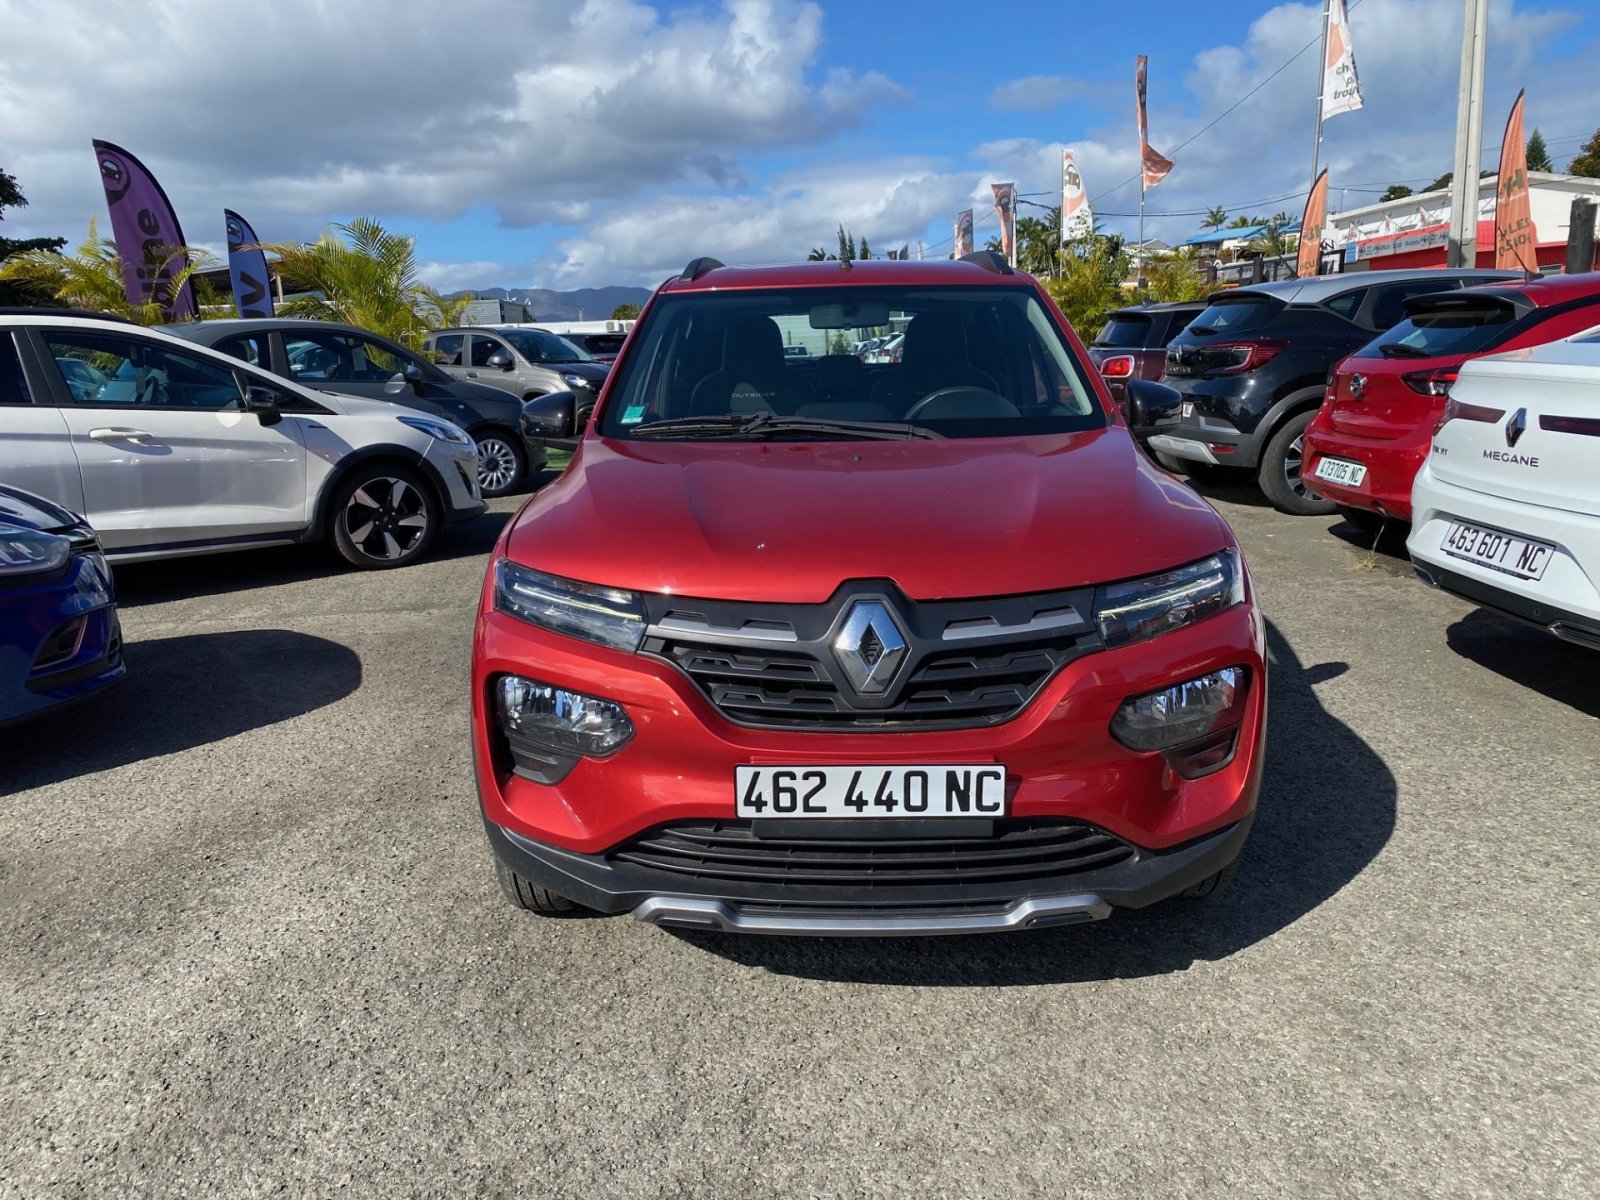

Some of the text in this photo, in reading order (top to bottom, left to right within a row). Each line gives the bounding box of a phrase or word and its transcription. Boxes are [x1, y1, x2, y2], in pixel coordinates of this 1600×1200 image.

[1483, 449, 1540, 467] MEGANE
[1348, 466, 1363, 483] NC
[1448, 525, 1480, 553] 463
[1476, 532, 1513, 563] 601
[1515, 543, 1546, 573] NC
[743, 770, 1001, 813] 462 440 NC
